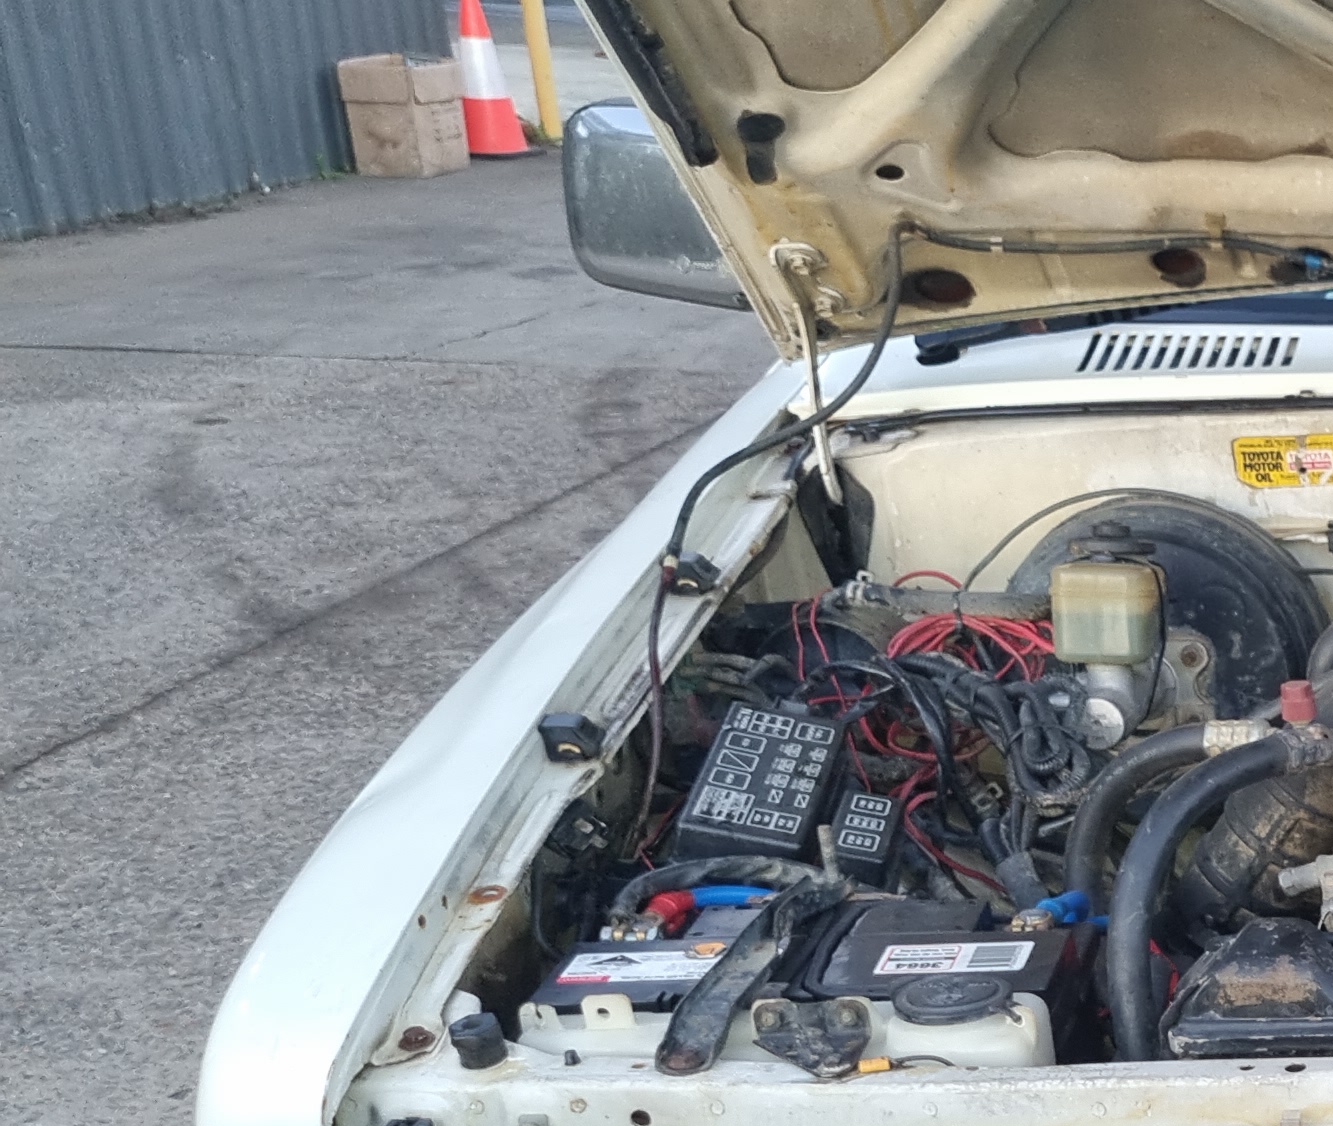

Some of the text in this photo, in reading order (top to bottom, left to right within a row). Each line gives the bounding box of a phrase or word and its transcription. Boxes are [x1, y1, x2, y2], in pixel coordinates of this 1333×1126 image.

[1241, 451, 1284, 462] TOYOTA
[1289, 452, 1330, 461] TYOTA
[1243, 462, 1284, 473] MOTOR
[1255, 473, 1273, 482] OIL
